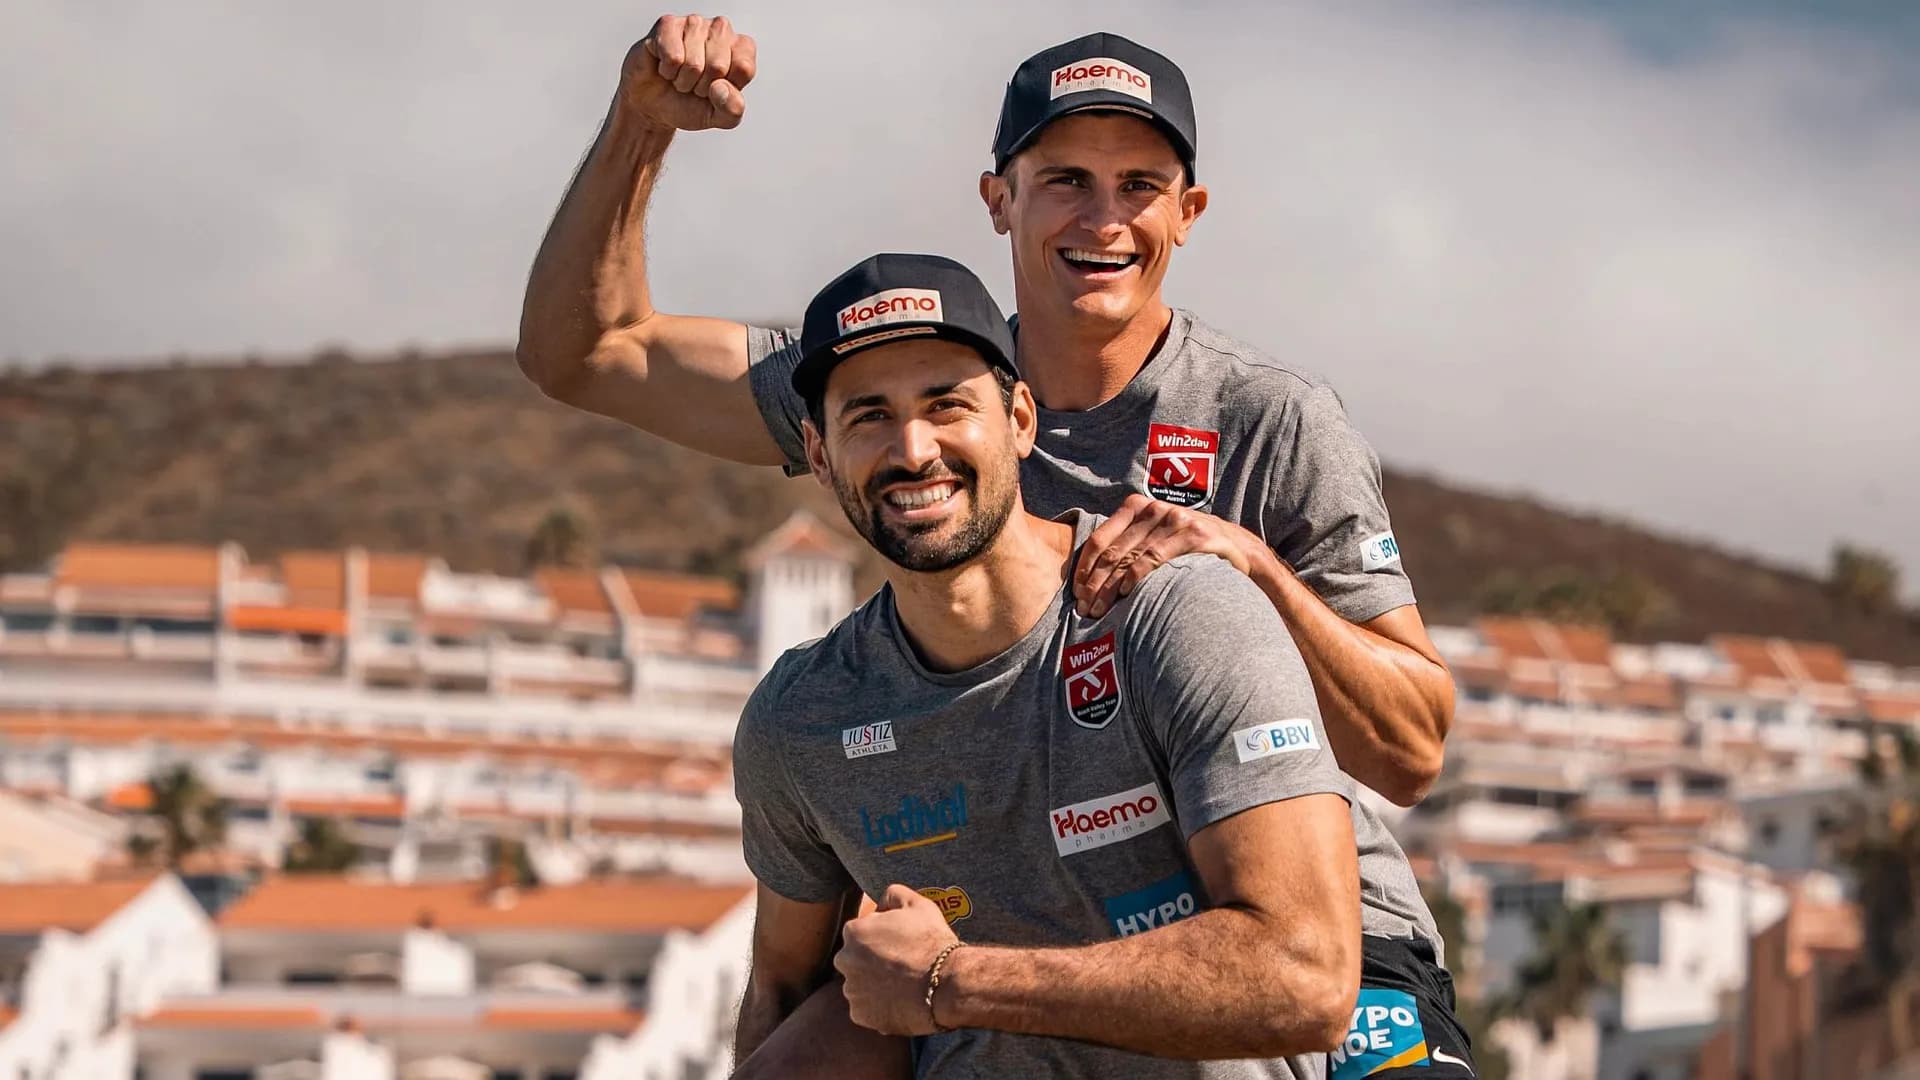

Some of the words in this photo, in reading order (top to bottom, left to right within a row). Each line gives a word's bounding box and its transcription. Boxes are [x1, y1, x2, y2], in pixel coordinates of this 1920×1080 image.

[1055, 65, 1146, 88] Haemo
[841, 297, 935, 329] Haemo
[1270, 726, 1311, 748] BBV
[858, 782, 967, 848] Ladival
[1054, 796, 1157, 838] Haemo
[1075, 820, 1146, 849] pharma
[1117, 893, 1194, 937] HYPO
[1349, 1006, 1415, 1032] YPO
[1330, 1028, 1393, 1072] NOE
